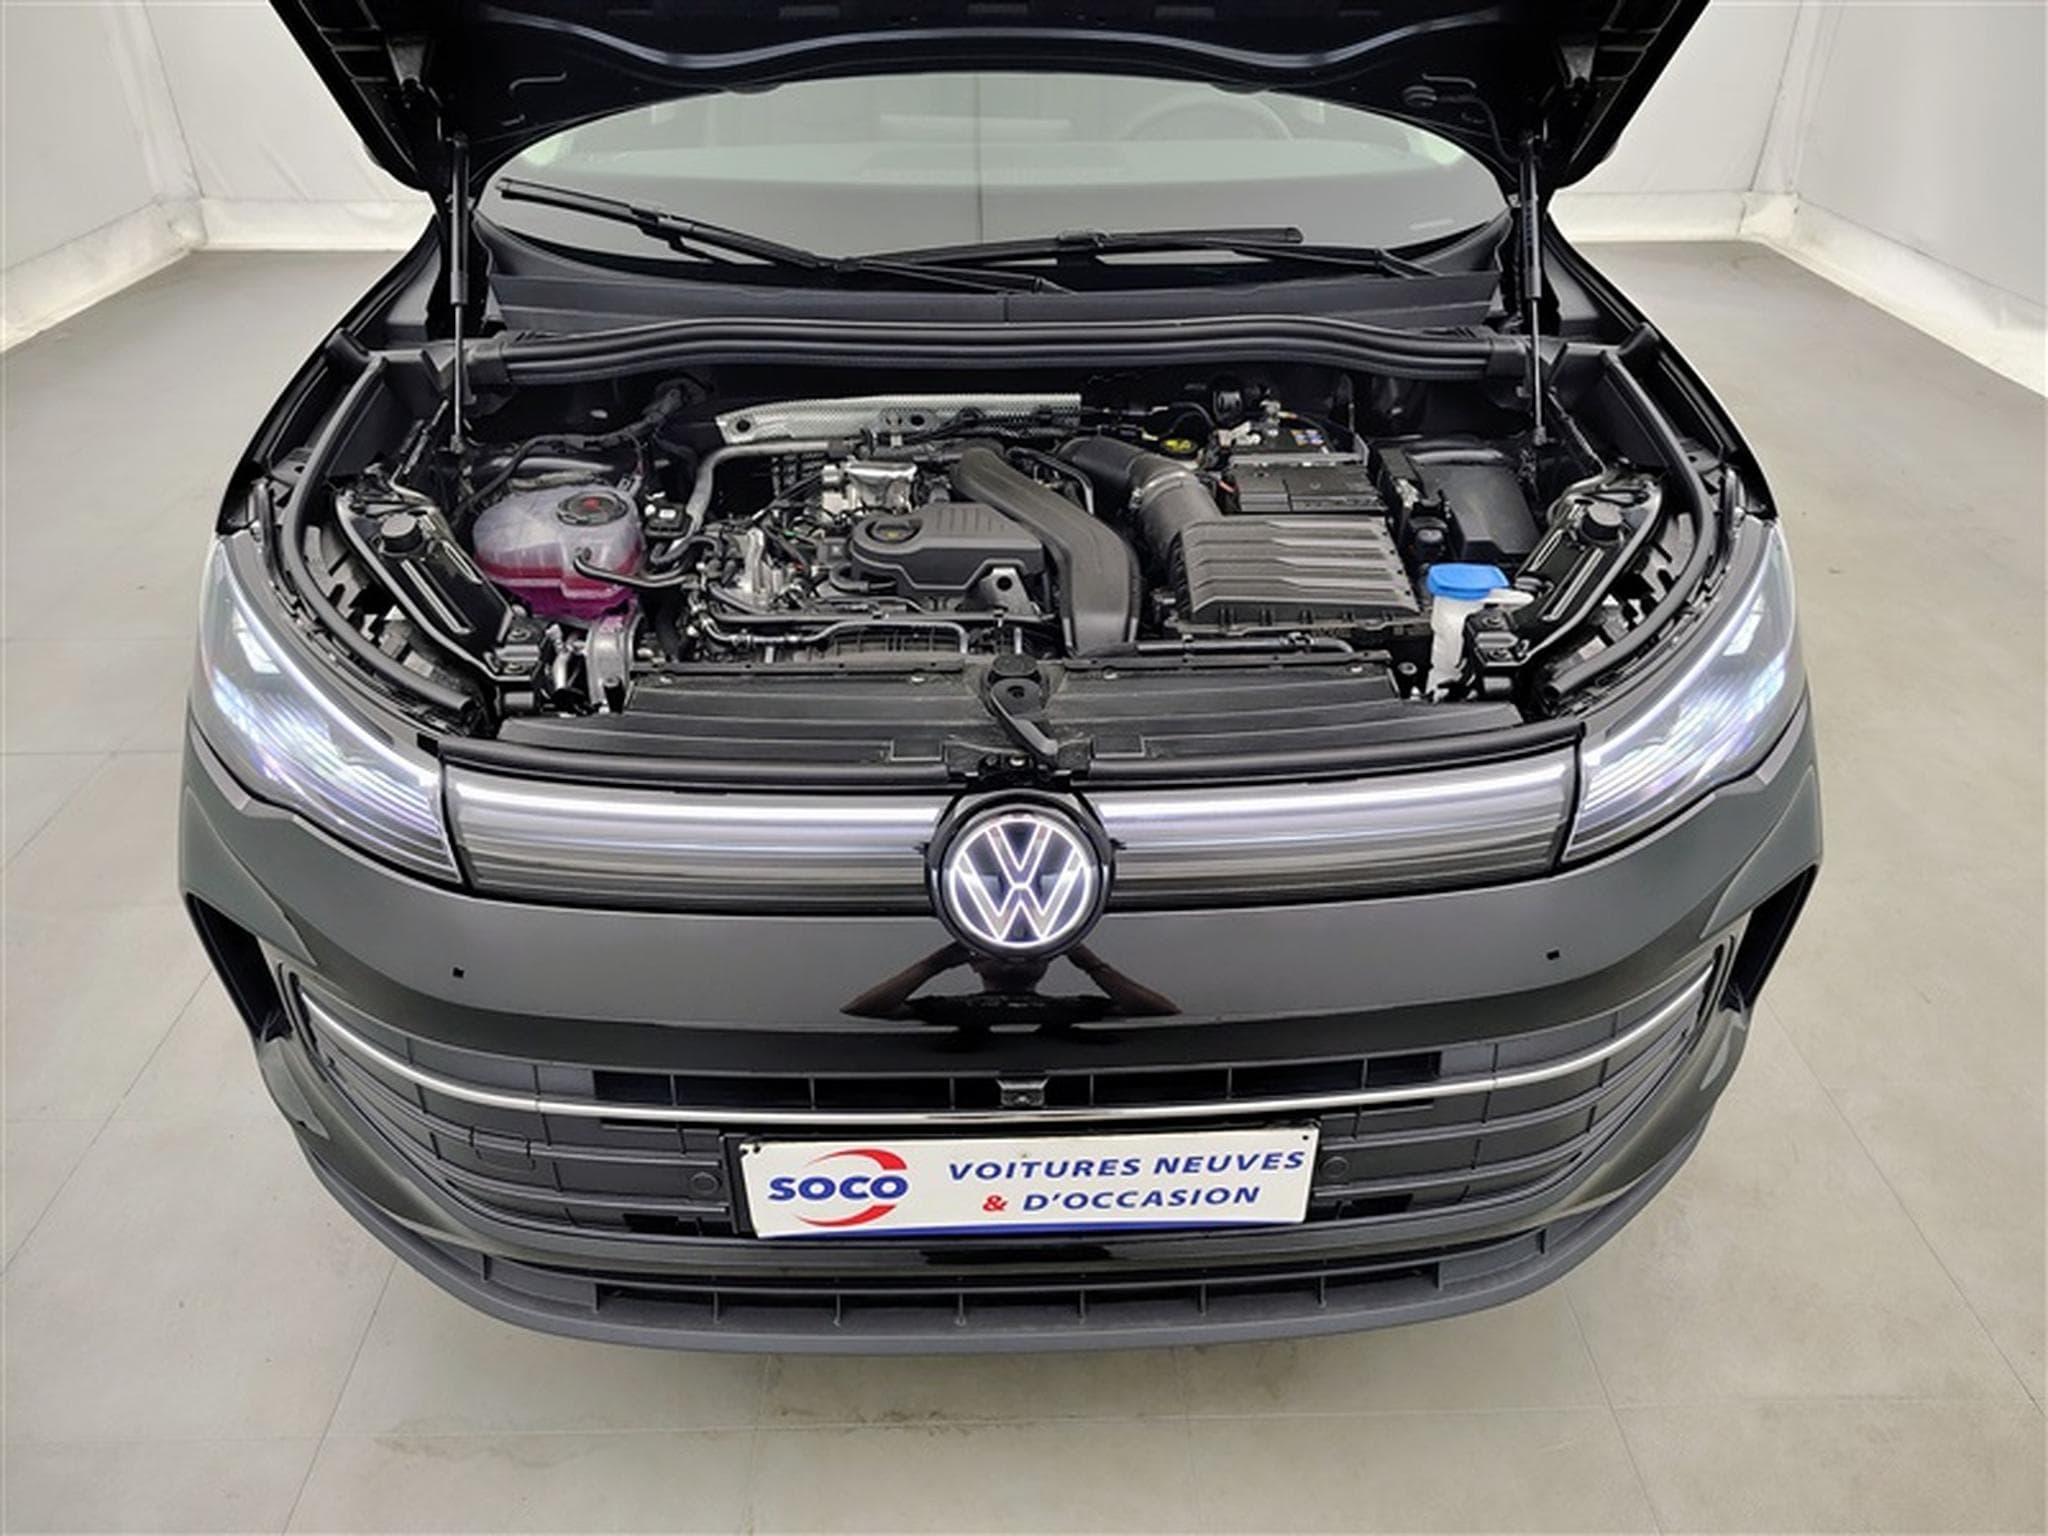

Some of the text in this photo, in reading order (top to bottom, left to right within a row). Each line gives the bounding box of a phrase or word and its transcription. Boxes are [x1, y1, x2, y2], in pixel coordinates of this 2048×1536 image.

[949, 1151, 1305, 1182] VOITURES NEUVES
[768, 1174, 909, 1202] SOCO
[981, 1193, 1008, 1214] &
